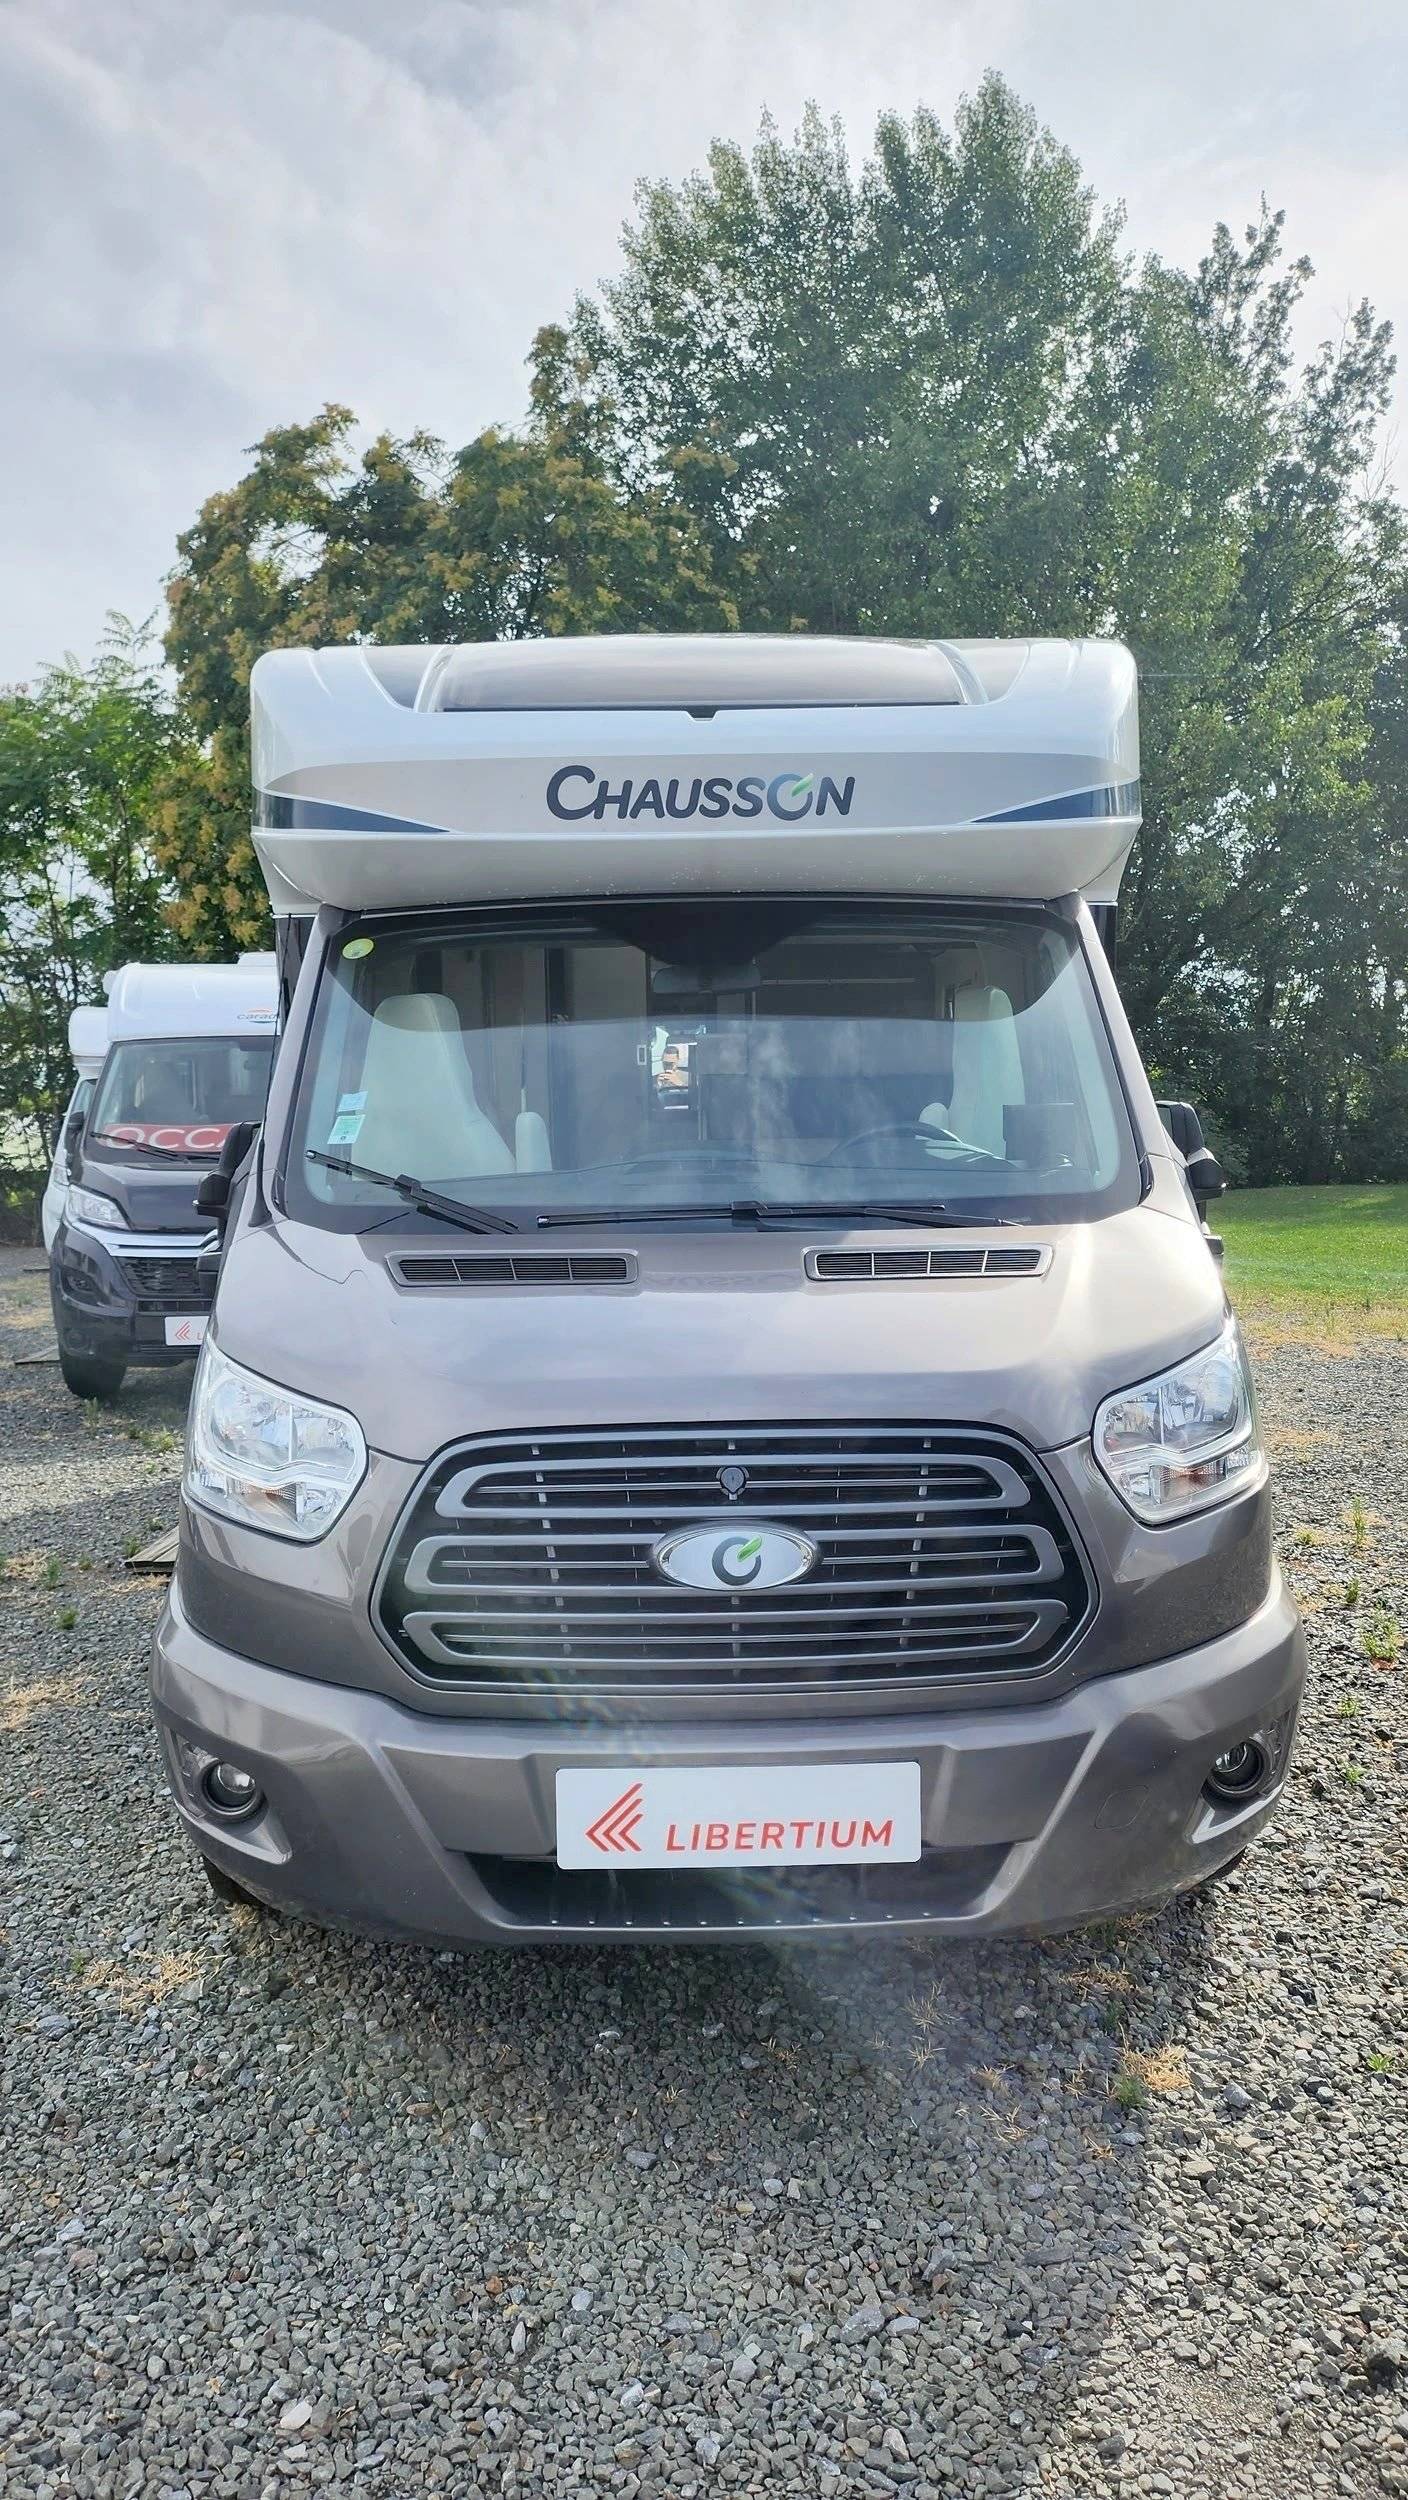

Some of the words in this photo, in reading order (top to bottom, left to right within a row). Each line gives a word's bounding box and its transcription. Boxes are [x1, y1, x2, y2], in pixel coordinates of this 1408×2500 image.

[546, 765, 856, 821] CHAUSSON
[106, 1127, 226, 1150] OCC
[666, 1820, 894, 1851] LIBERTIUM
